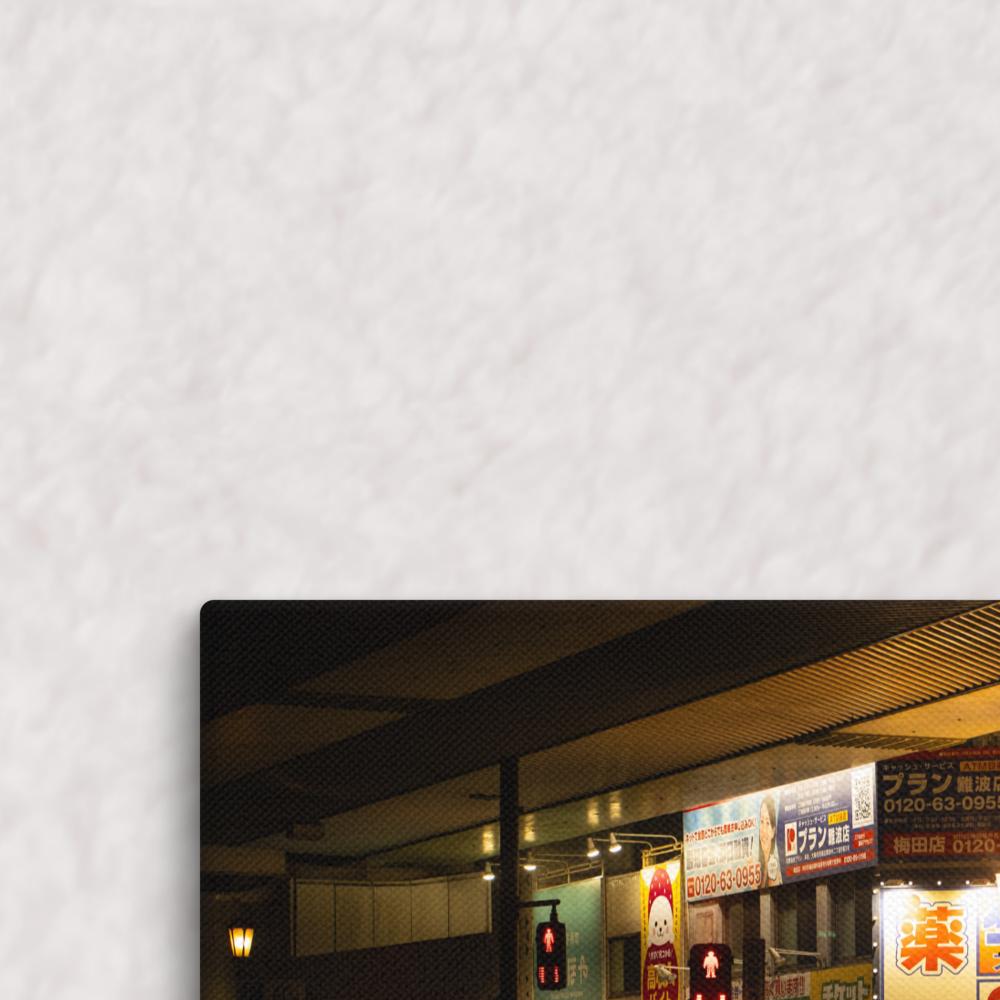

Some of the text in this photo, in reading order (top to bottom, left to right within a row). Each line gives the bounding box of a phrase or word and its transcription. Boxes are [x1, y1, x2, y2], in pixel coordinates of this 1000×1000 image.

[883, 773, 953, 797] プラン
[798, 829, 828, 852] プラン
[893, 836, 945, 854] 梅田店
[693, 864, 762, 896] 0120-63-0955
[899, 903, 965, 974] 薬
